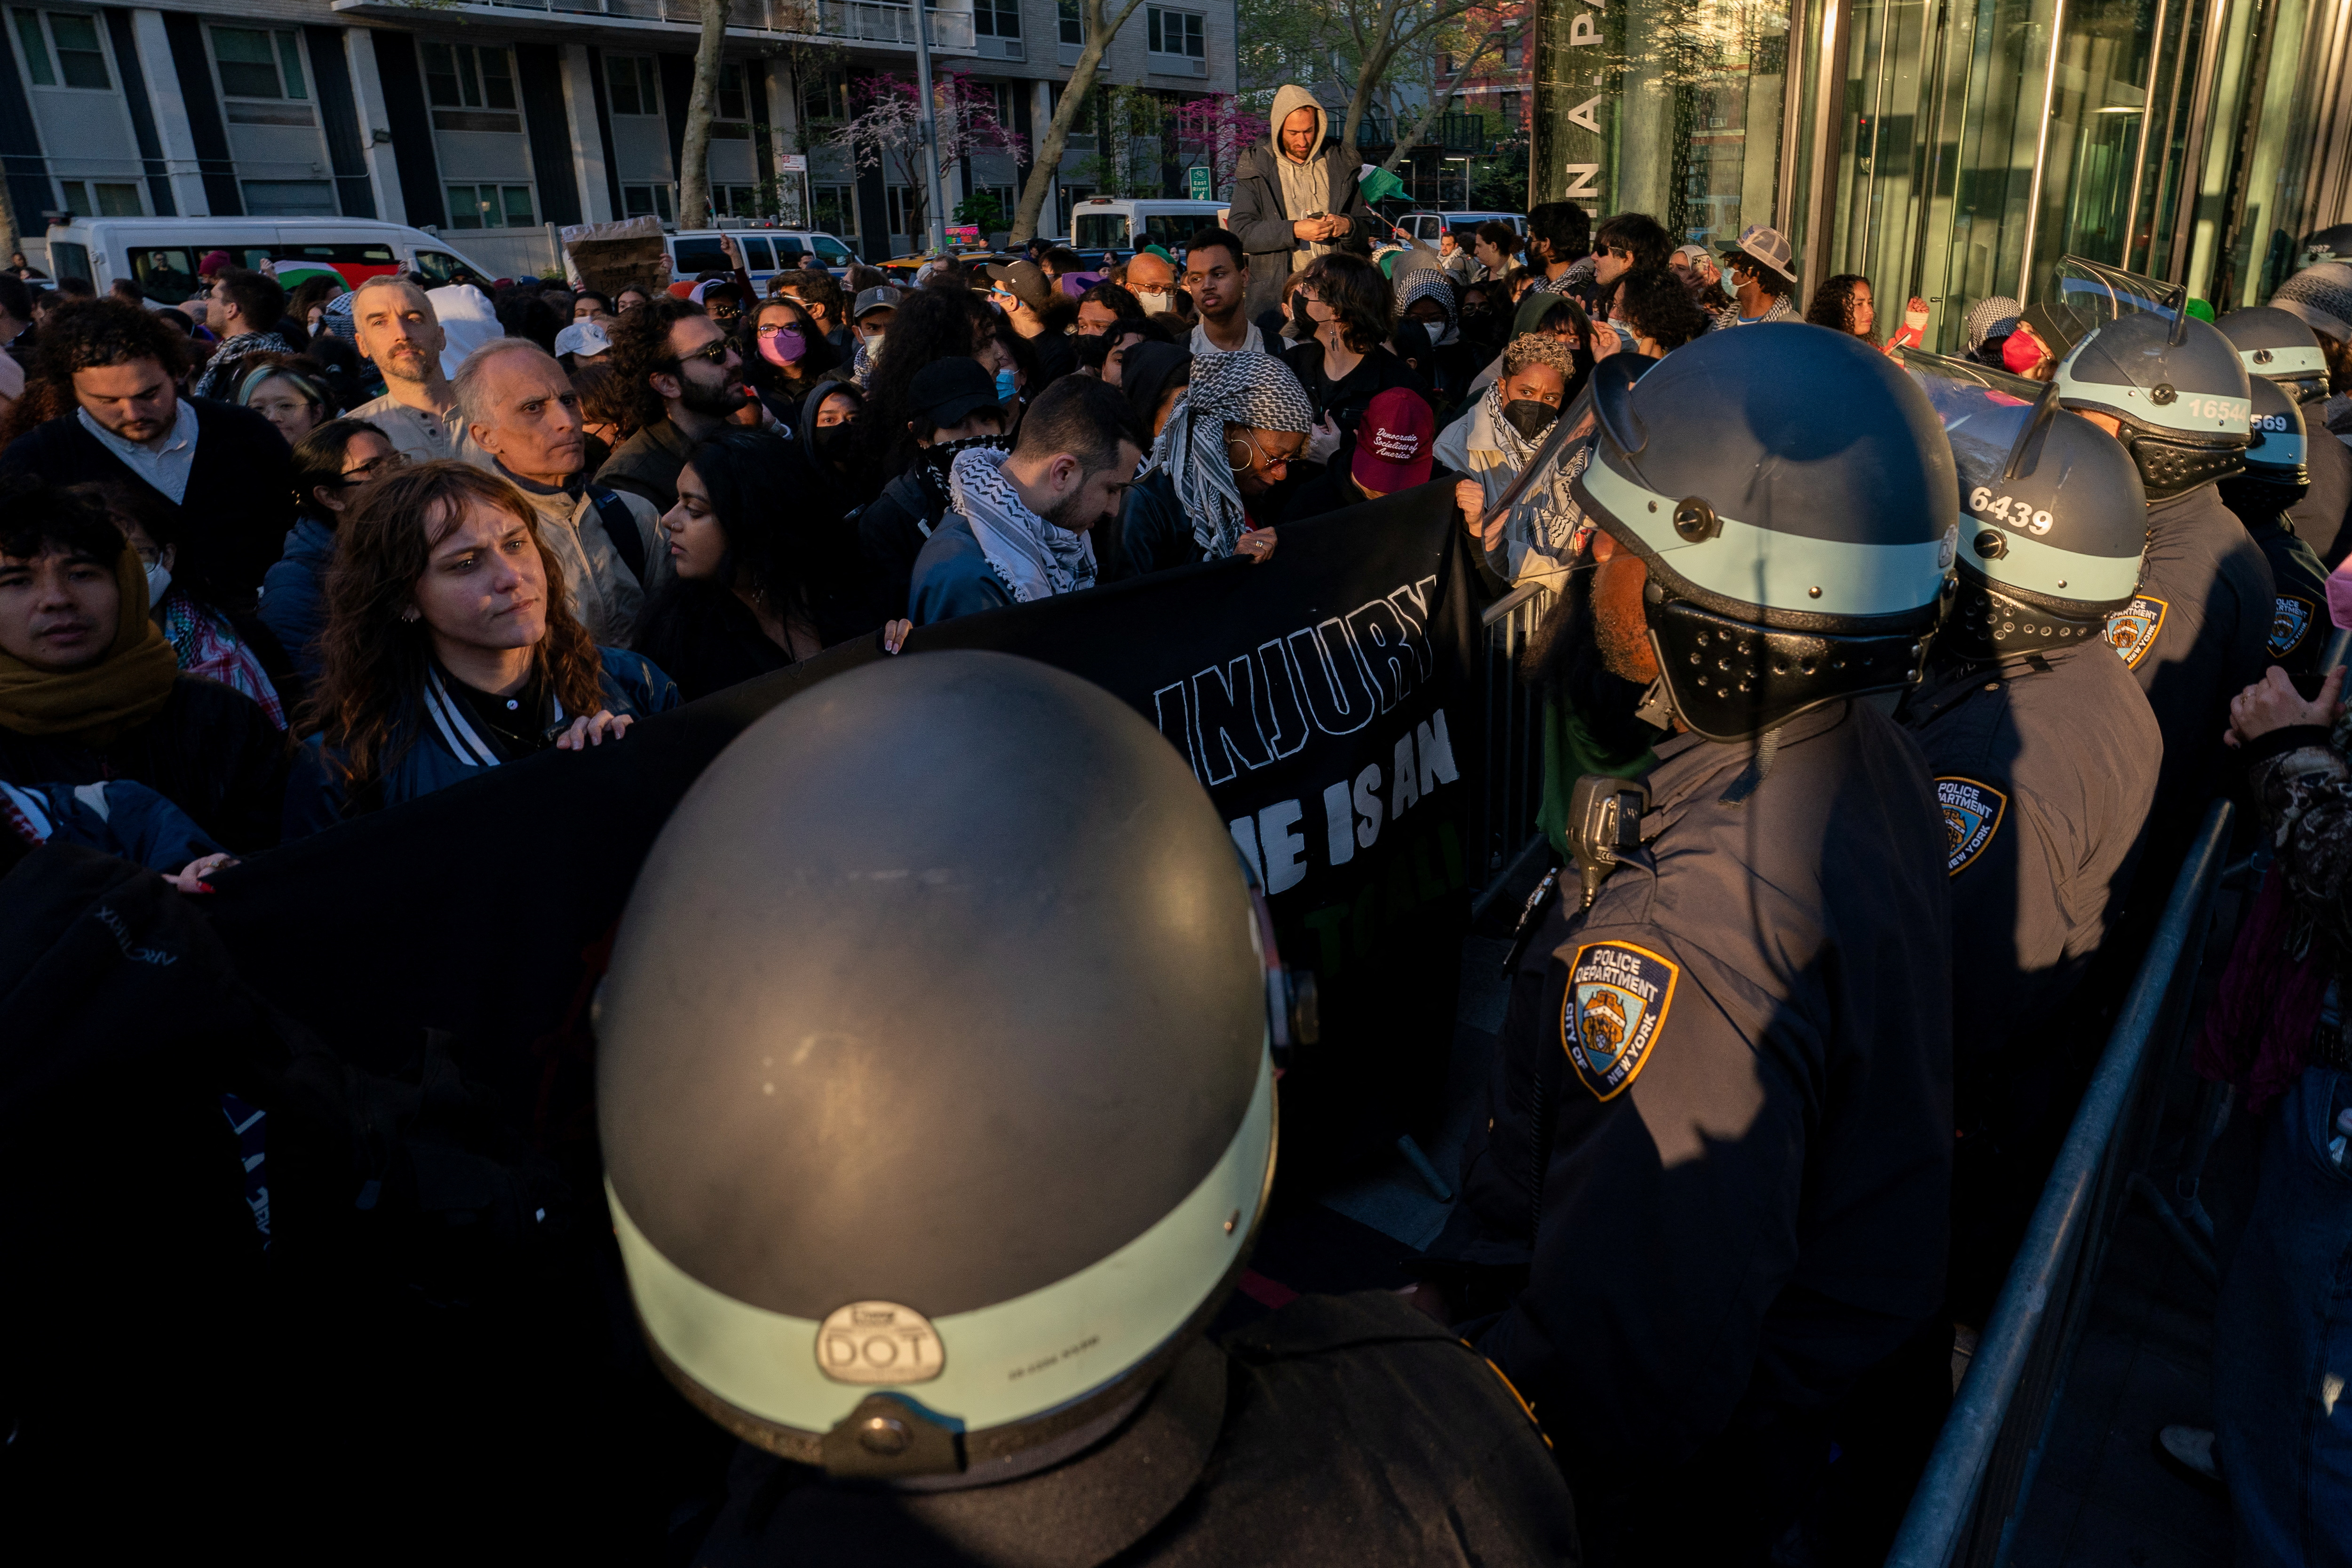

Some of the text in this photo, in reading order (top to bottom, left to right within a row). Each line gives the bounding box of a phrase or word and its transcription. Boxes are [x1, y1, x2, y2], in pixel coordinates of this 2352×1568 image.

[1568, 76, 1602, 134] A.
[609, 251, 627, 261] ON
[2189, 398, 2248, 422] 16544
[1374, 437, 1418, 453] Socialists of
[1376, 428, 1417, 441] Democratic
[1376, 448, 1411, 459] America
[1969, 486, 2053, 535] 6439
[2276, 598, 2299, 609] OLICE
[2126, 624, 2157, 663] NEW YORK
[2282, 621, 2308, 652] NEW YORK
[1154, 575, 1436, 785] INJURY
[1323, 763, 1383, 866] IS
[1392, 708, 1460, 820] AN
[1938, 782, 1980, 800] POLICE
[1965, 825, 1991, 853] YORK
[1303, 882, 1375, 979] TO
[1593, 949, 1641, 976] POLICE
[1574, 965, 1659, 1003] DEPARTMENT
[1565, 1002, 1657, 1086] CITY OF NEW YORK
[826, 1333, 926, 1369] DOT
